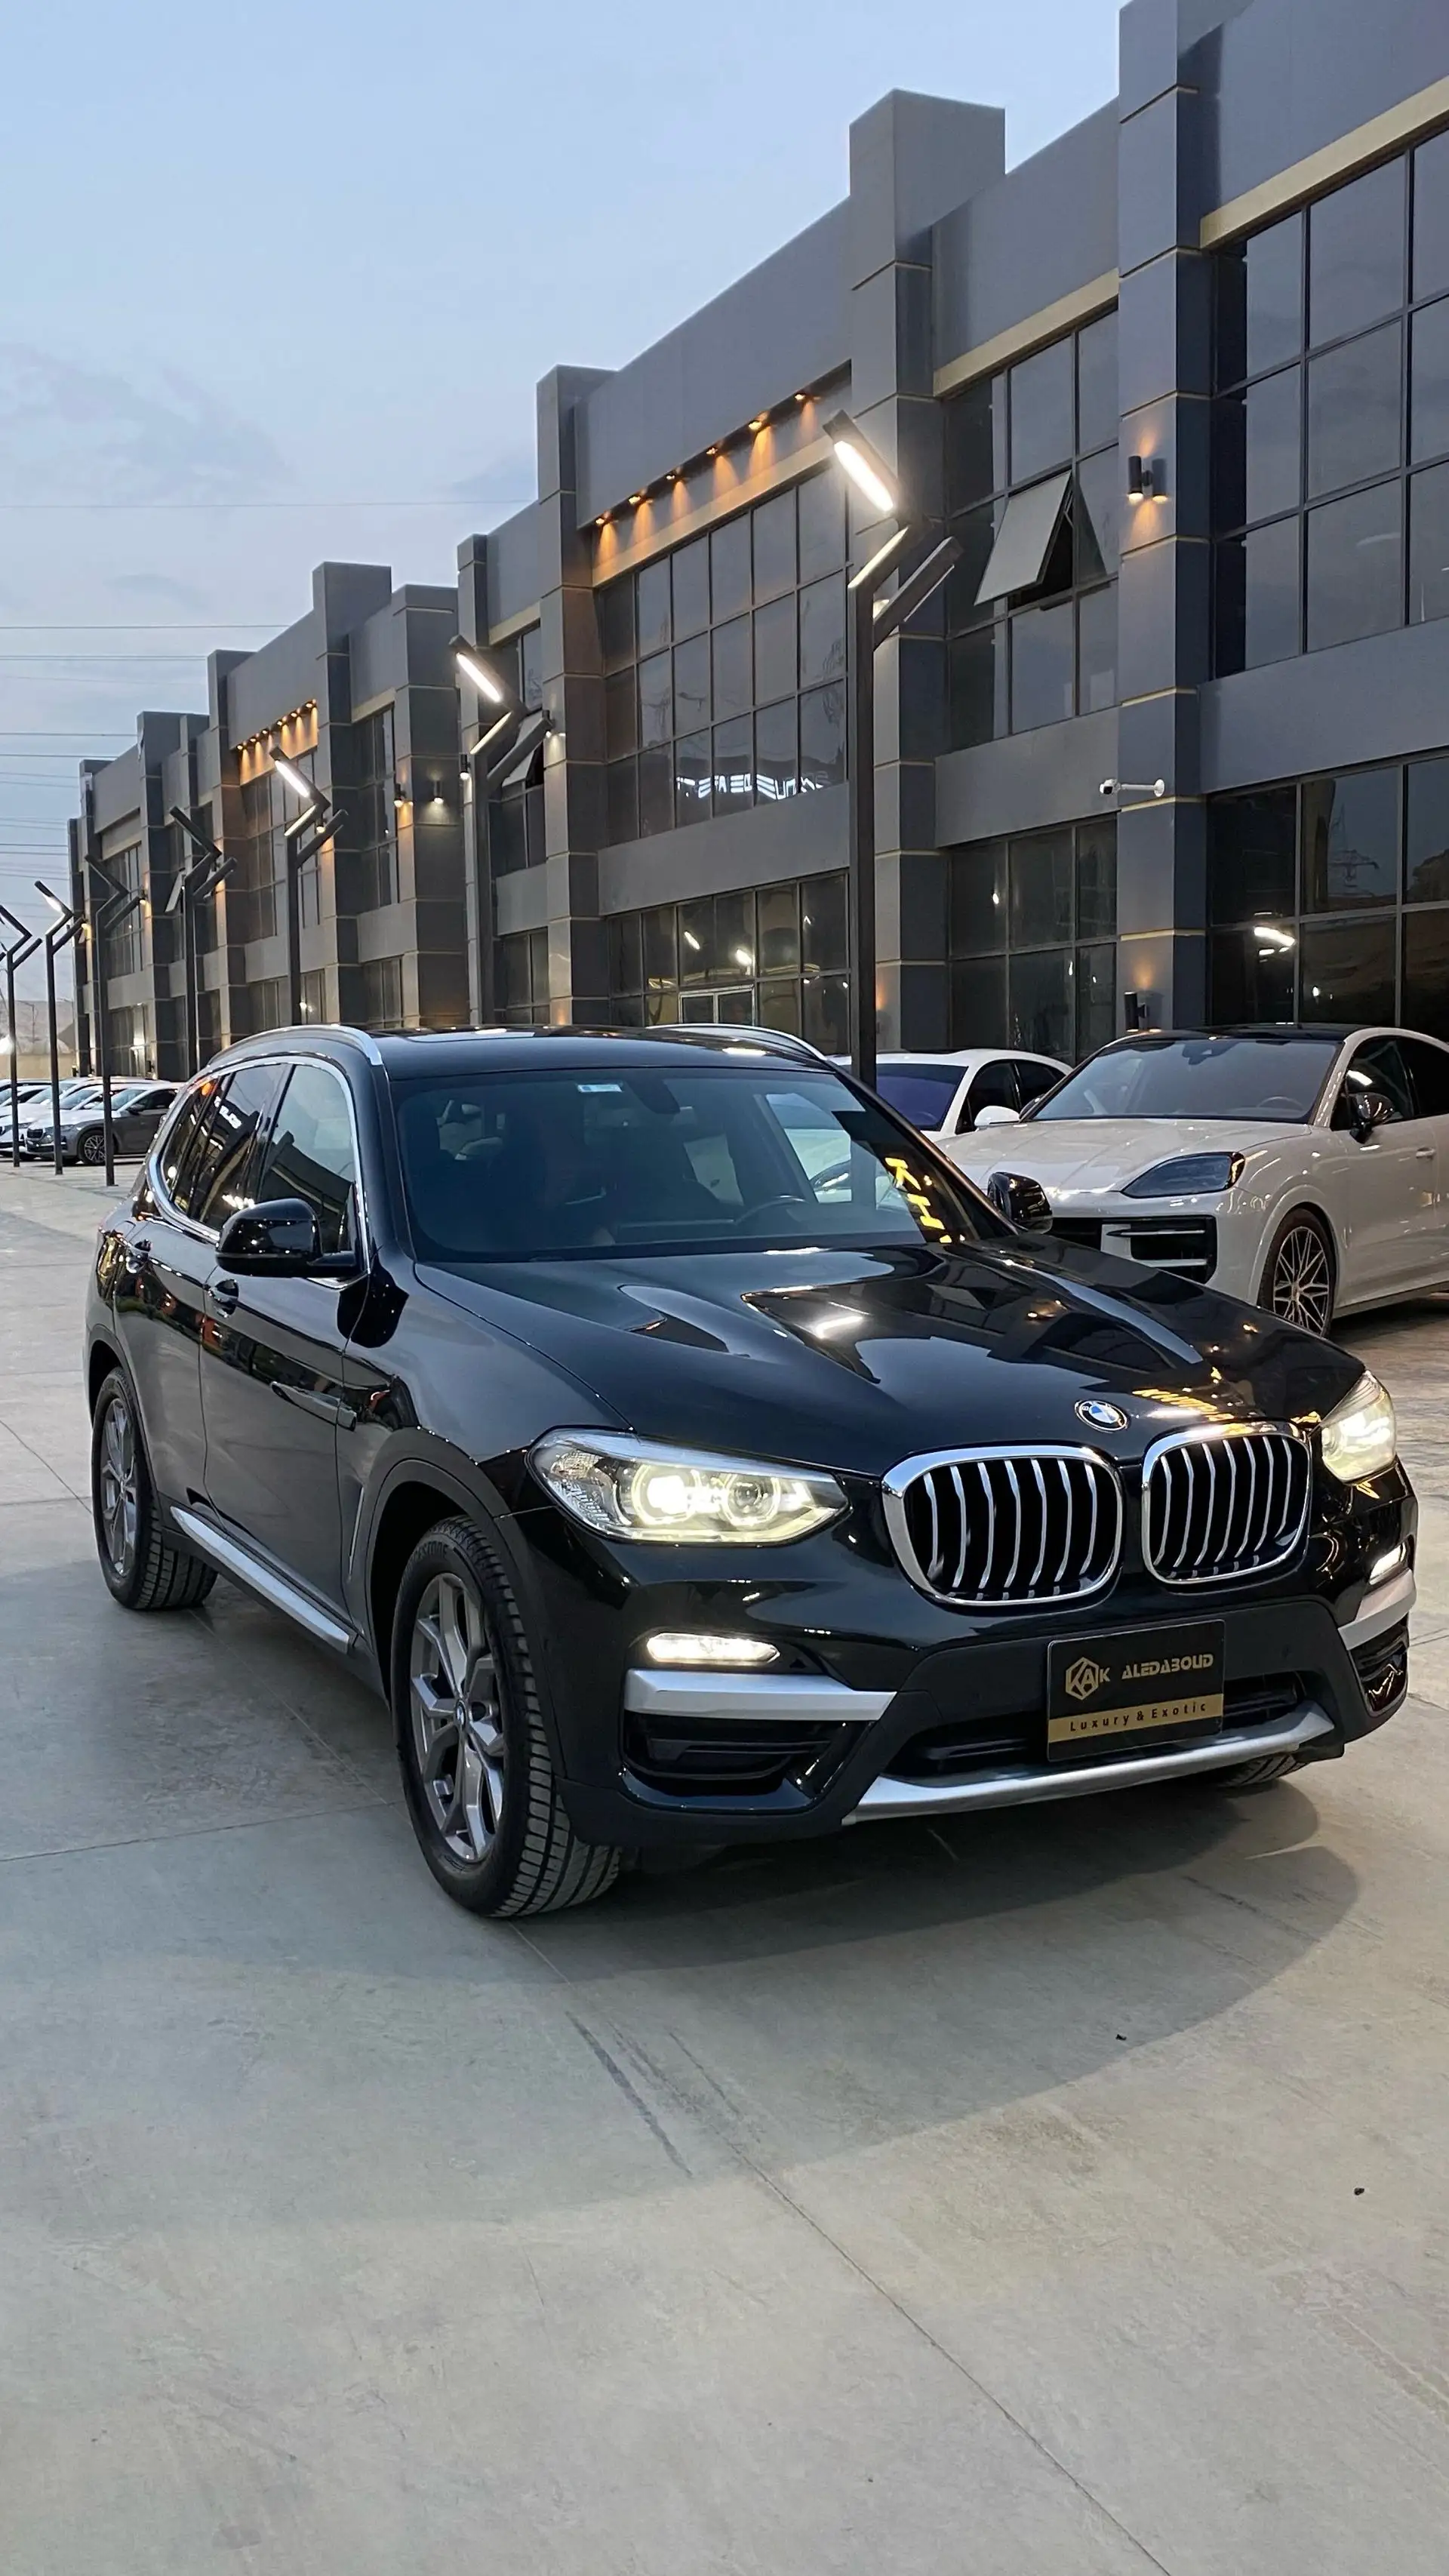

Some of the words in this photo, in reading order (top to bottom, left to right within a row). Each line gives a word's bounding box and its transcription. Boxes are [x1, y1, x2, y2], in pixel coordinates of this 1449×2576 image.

[1121, 1654, 1214, 1679] ALEDABOUD
[1070, 1714, 1129, 1731] Luxury
[1137, 1710, 1144, 1721] &
[1151, 1701, 1206, 1719] Exotic
